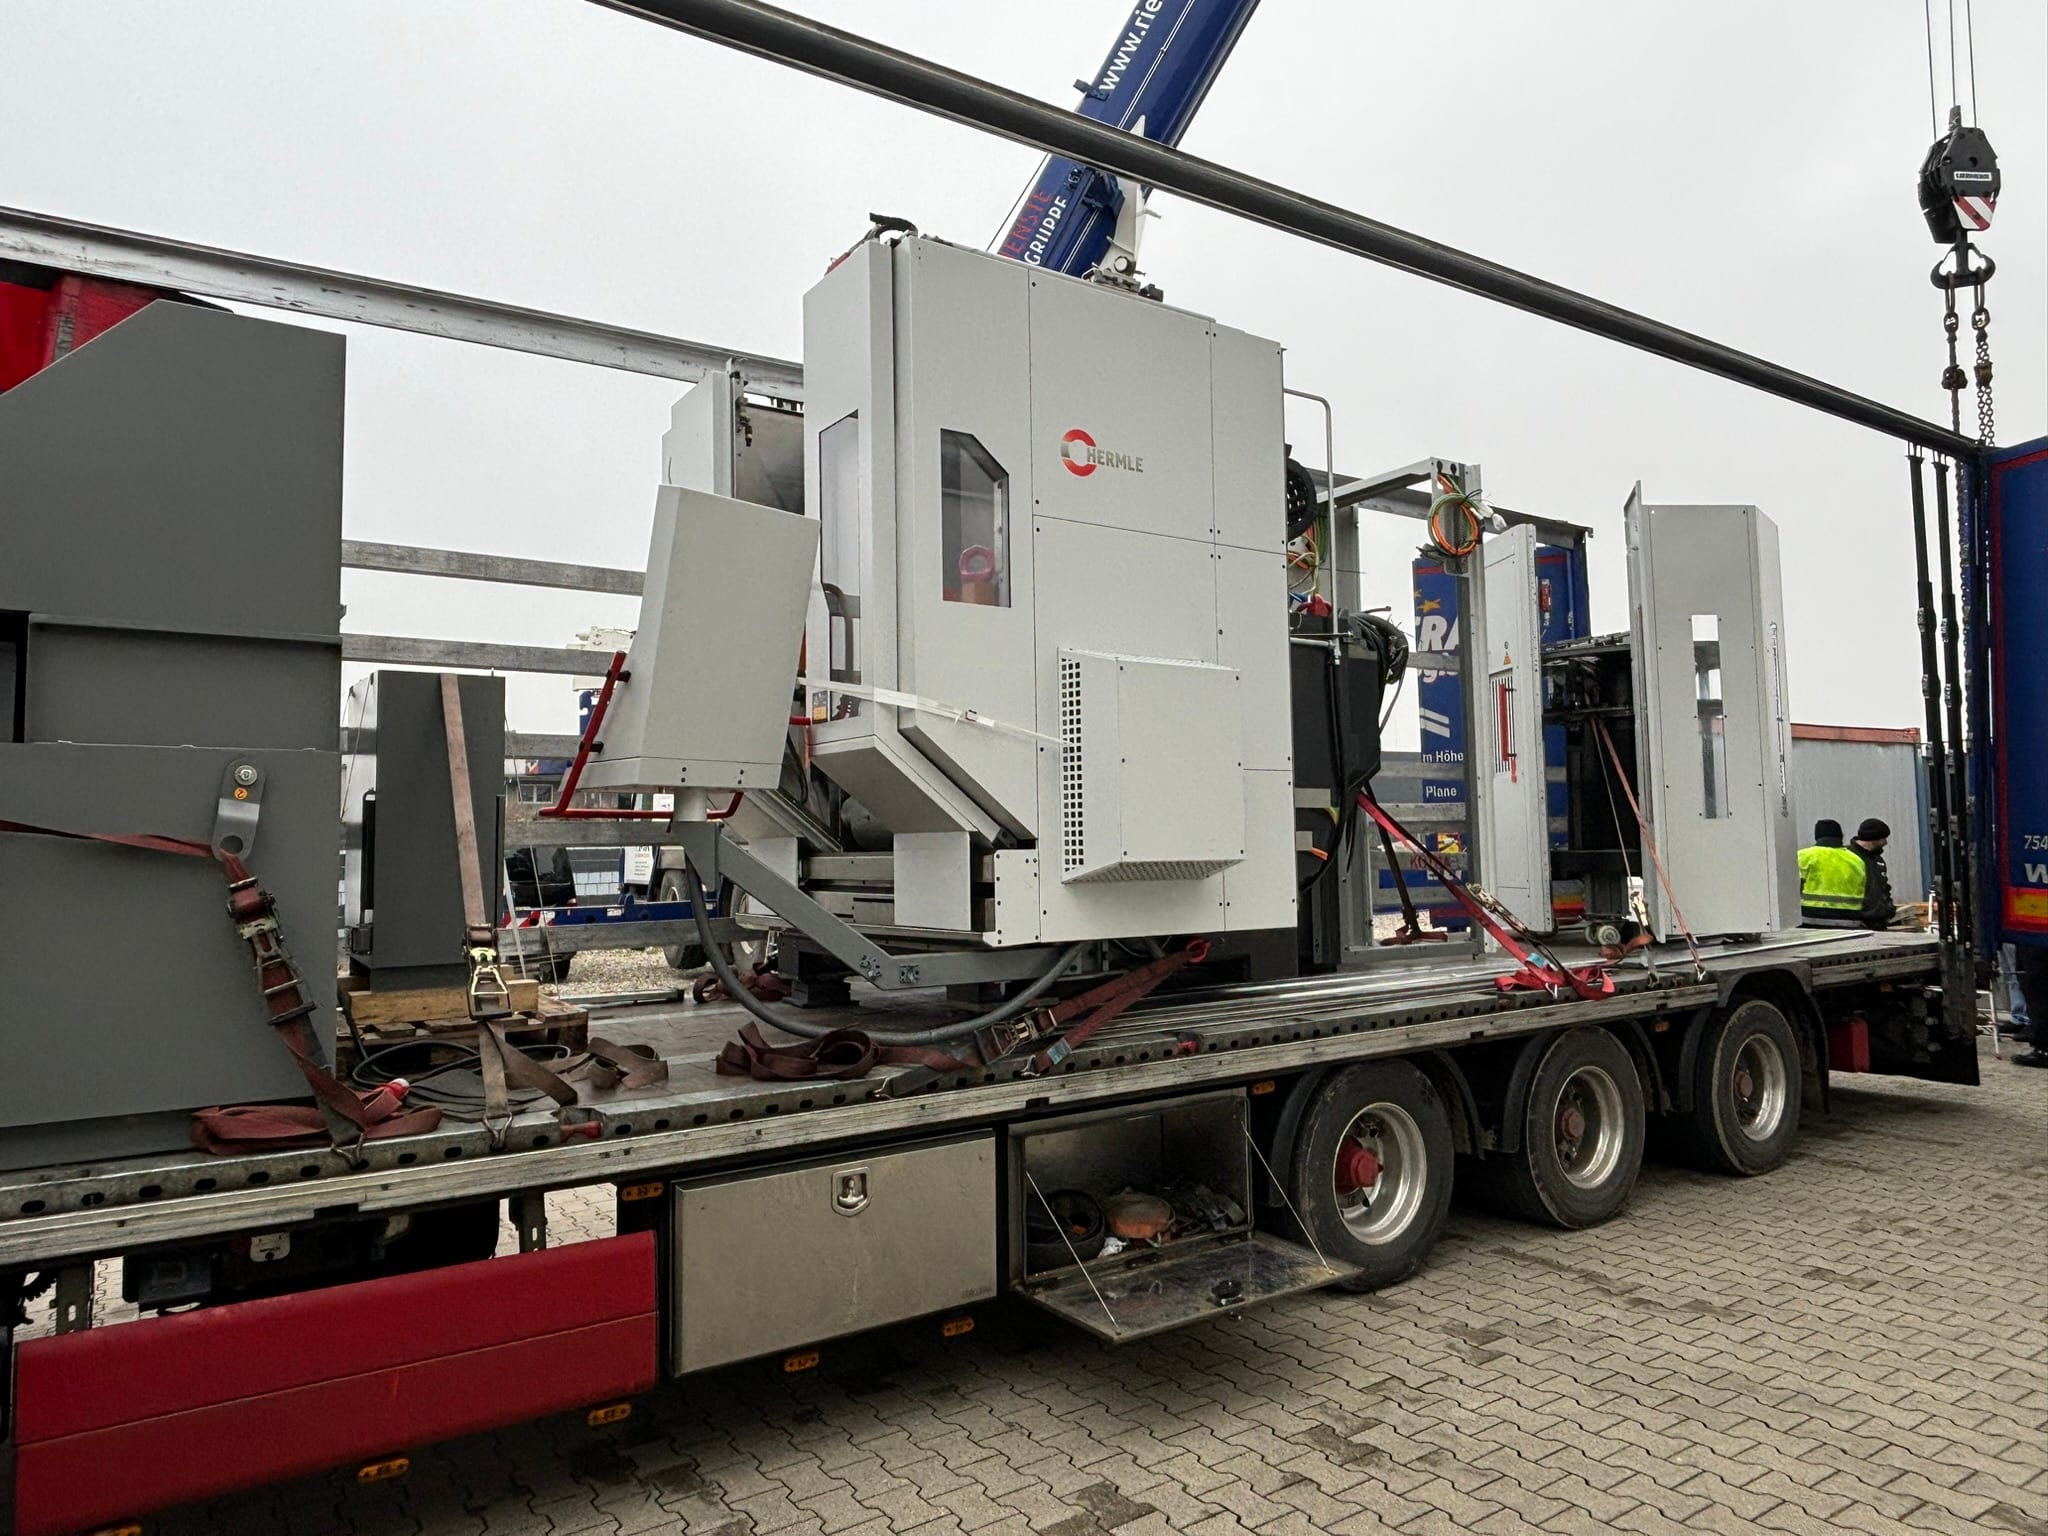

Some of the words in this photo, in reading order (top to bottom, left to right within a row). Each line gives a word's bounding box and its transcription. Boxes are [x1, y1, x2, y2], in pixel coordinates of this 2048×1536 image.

[1087, 446, 1144, 473] HERMLE
[1435, 750, 1464, 763] Höhe
[1425, 785, 1457, 798] Plane
